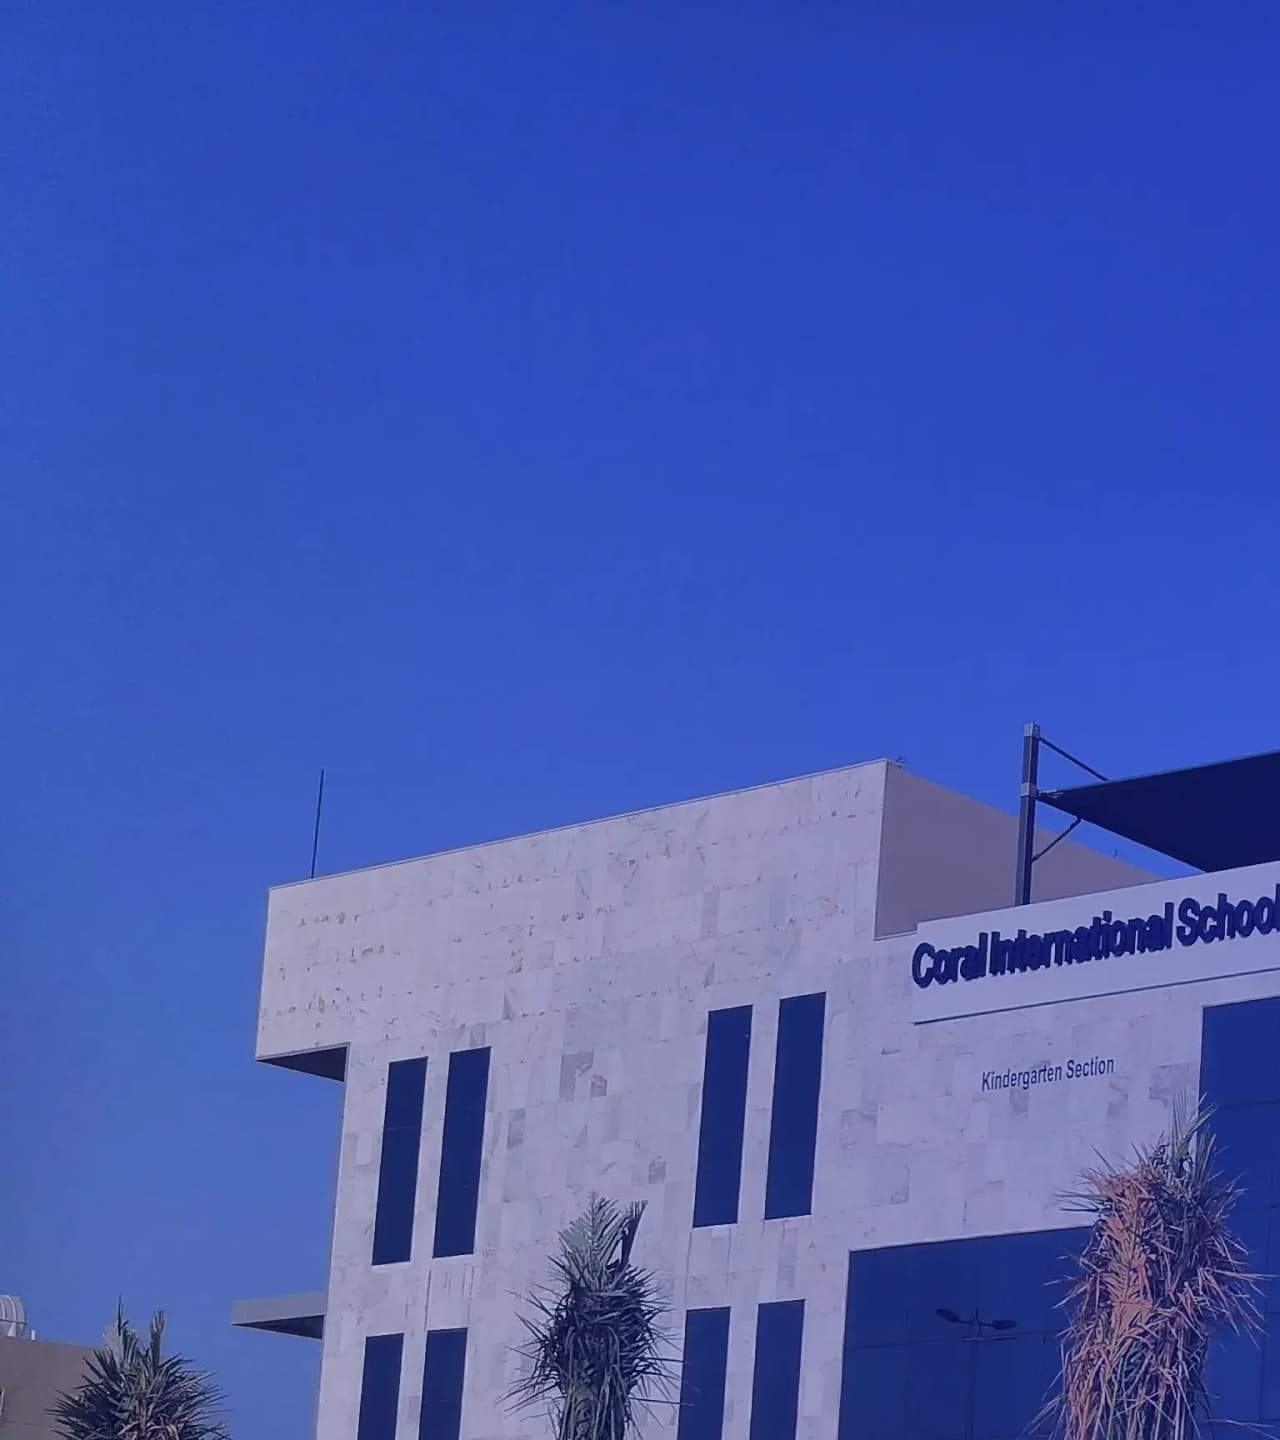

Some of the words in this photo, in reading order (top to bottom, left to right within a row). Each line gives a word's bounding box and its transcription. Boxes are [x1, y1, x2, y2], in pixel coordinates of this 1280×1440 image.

[912, 931, 988, 988] Coral
[989, 901, 1174, 977] International
[981, 1066, 1062, 1092] Kindergarten
[1065, 1056, 1115, 1079] Section
